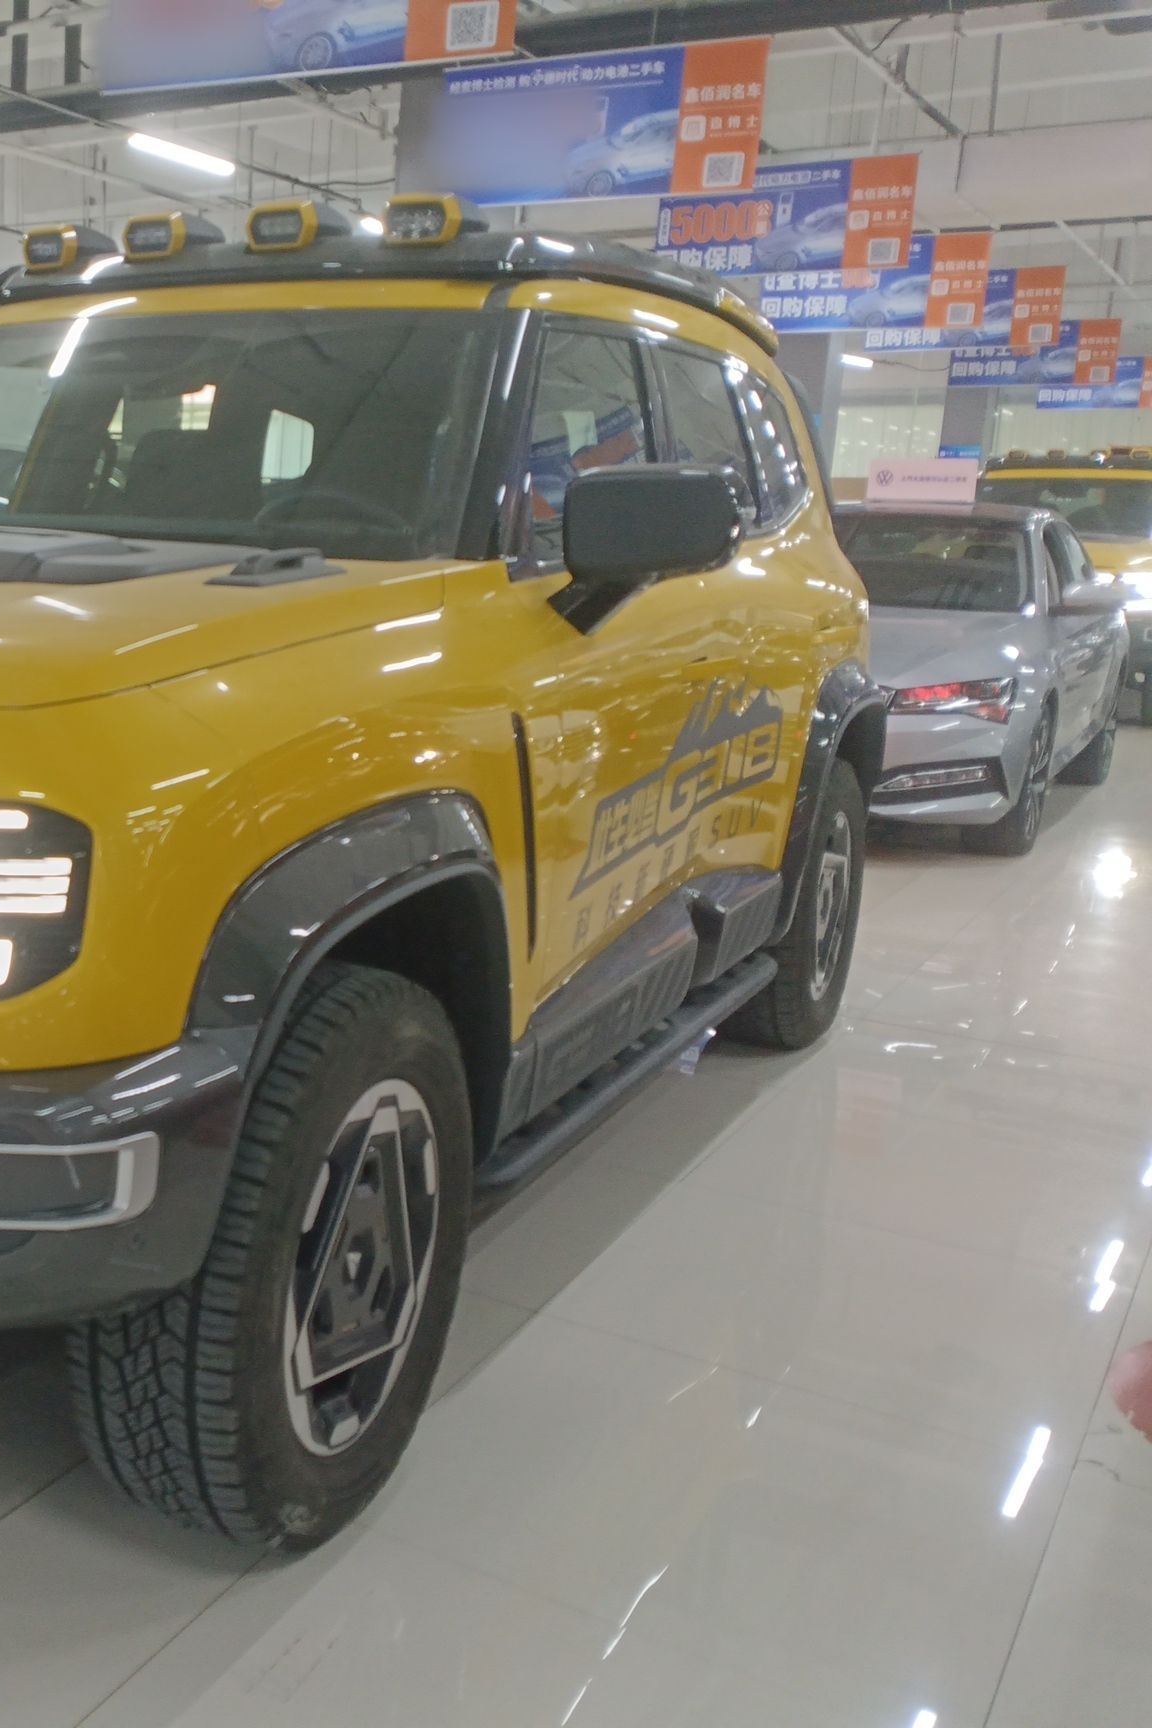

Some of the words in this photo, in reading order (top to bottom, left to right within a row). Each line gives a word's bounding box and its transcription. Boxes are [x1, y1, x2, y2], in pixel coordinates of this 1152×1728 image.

[671, 201, 757, 245] 5000
[761, 294, 848, 319] 回购保障
[865, 329, 941, 347] 回购保障
[952, 361, 1017, 377] 回购保障
[1038, 388, 1093, 402] 回购保障
[710, 800, 764, 850] SUV
